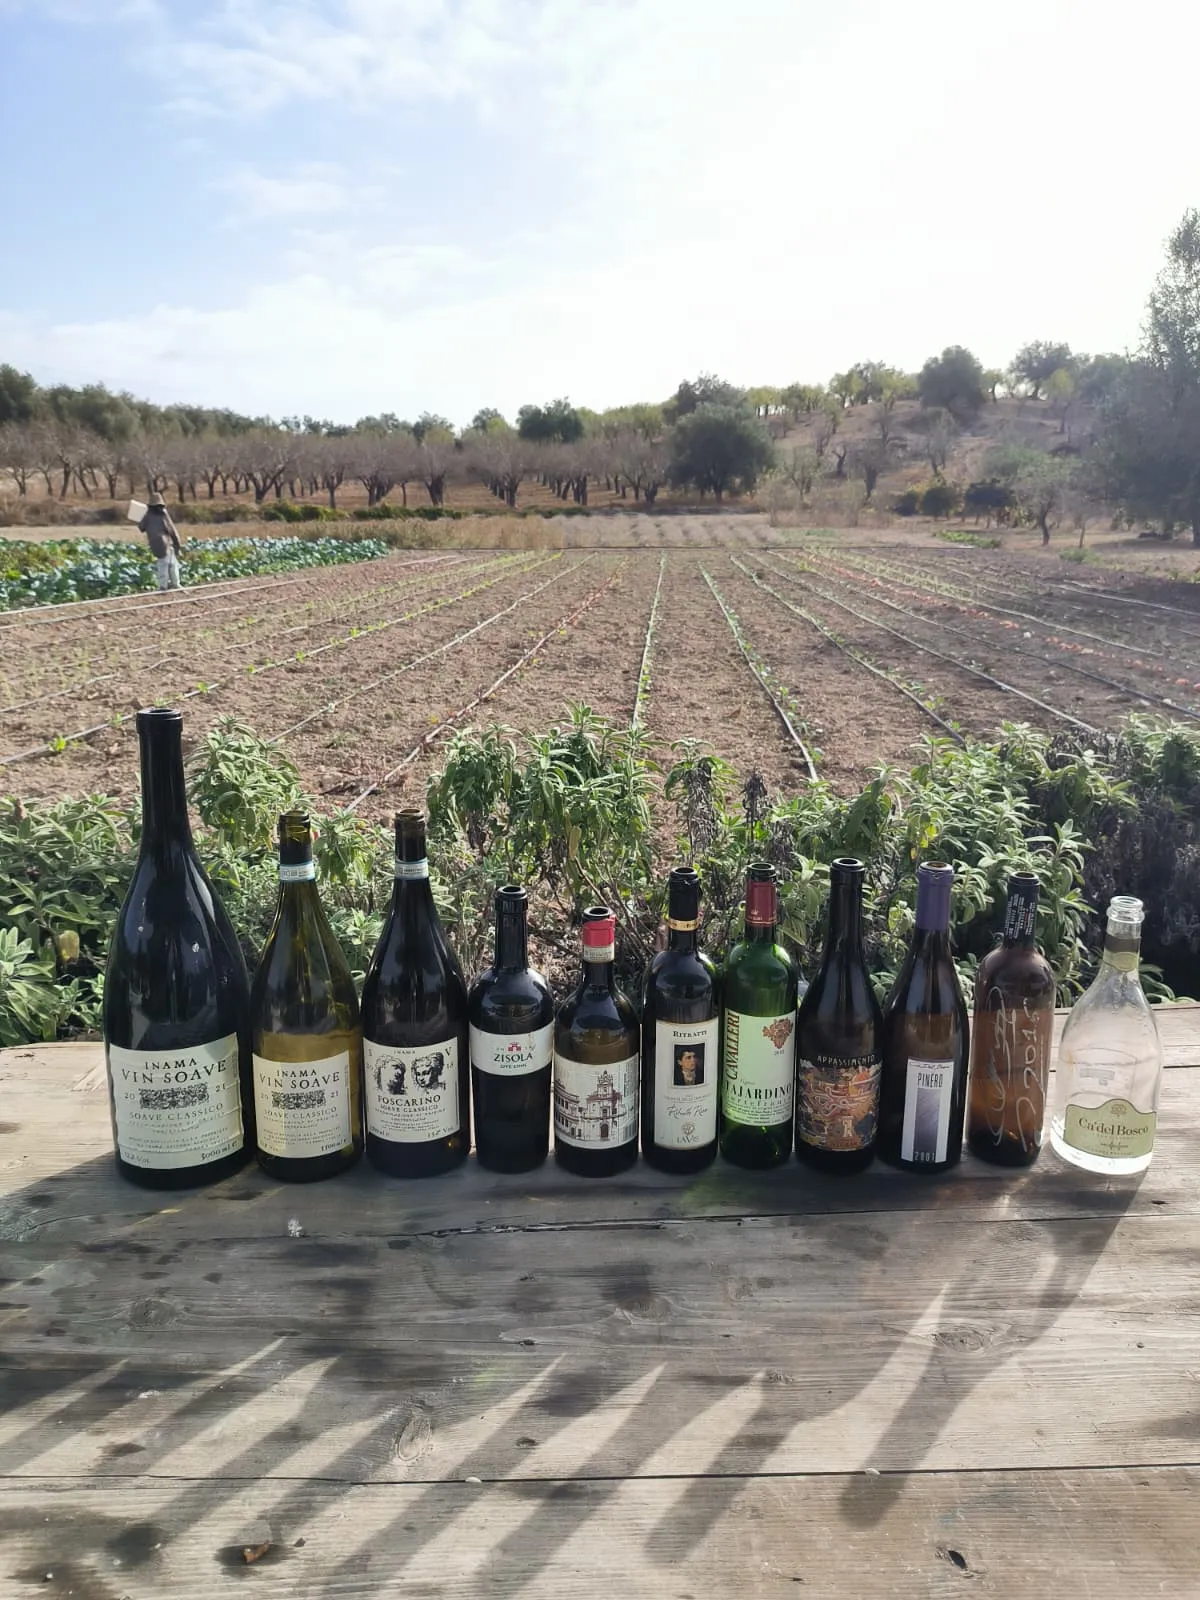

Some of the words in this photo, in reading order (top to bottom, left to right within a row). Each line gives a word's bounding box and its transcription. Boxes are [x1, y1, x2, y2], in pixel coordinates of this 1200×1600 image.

[726, 1011, 740, 1080] CAVALLERI
[494, 1052, 533, 1062] ZISOLA
[145, 1058, 197, 1070] INAMA
[122, 1069, 153, 1083] VIN
[164, 1060, 227, 1083] SOAVE
[277, 1069, 317, 1078] INAMA
[260, 1073, 283, 1088] VIN
[291, 1072, 340, 1089] SOAVE
[917, 1072, 944, 1088] PINERO
[377, 1094, 441, 1107] FOSCARINO
[130, 1112, 162, 1121] SOAVE
[168, 1103, 223, 1121] CLASSICO
[293, 1106, 337, 1119] CLASSICO
[1117, 1124, 1149, 1136] Bosco
